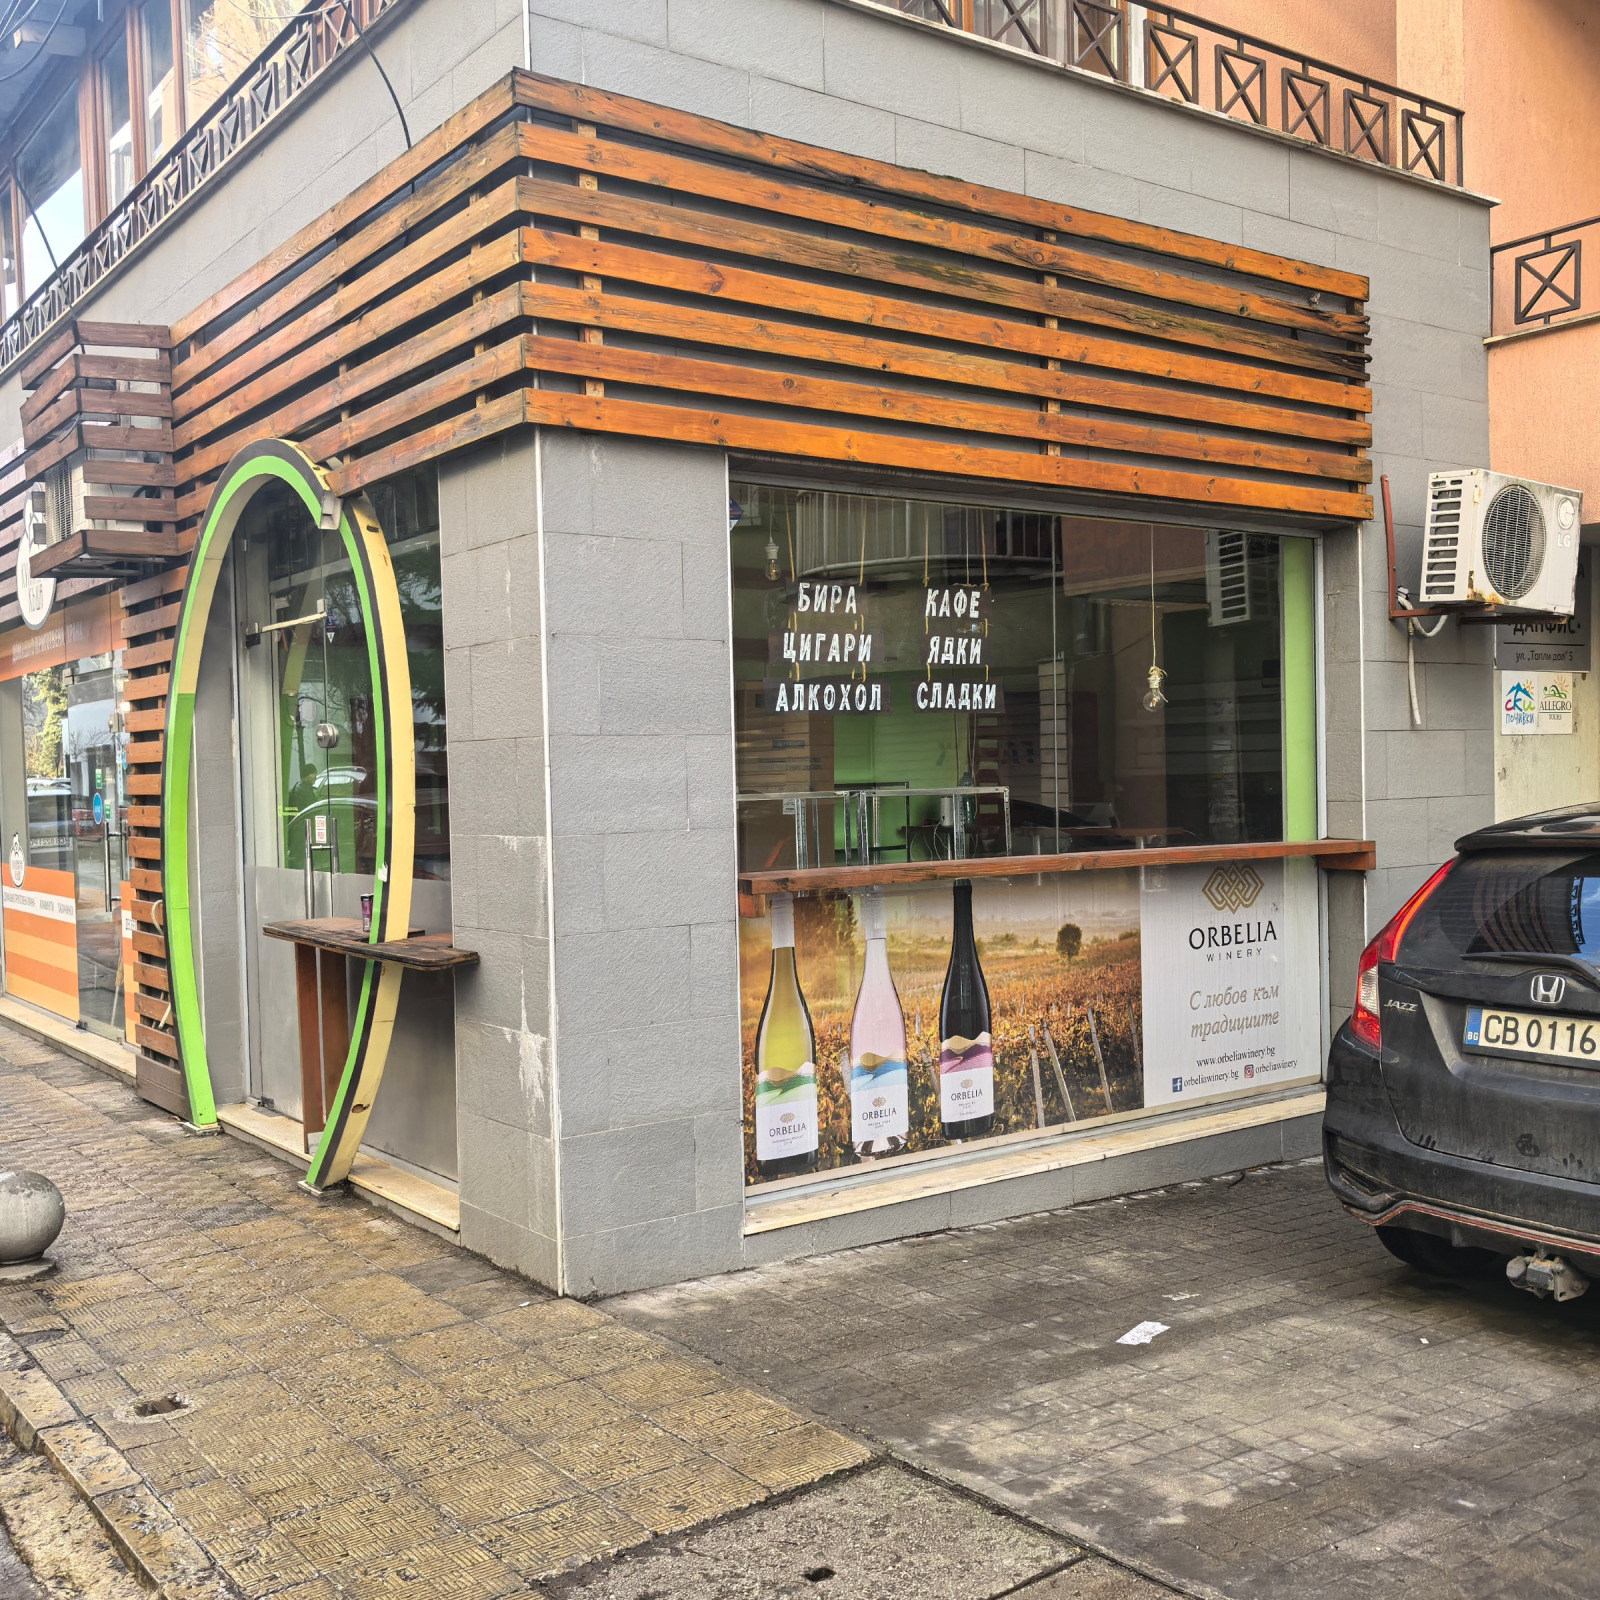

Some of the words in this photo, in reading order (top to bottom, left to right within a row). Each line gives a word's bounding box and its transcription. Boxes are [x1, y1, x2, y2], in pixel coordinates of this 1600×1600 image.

[1557, 532, 1571, 548] LG
[797, 582, 857, 614] БИРА
[925, 588, 980, 618] КАФЕ
[783, 632, 872, 663] ЦИГАРИ
[927, 635, 982, 665] ЯДКИ
[775, 683, 881, 711] АЛКОХОЛ
[916, 681, 996, 710] СЛАДКИ
[1540, 700, 1572, 711] ALLEGRO
[1189, 920, 1277, 950] ORBELIA
[1207, 947, 1262, 962] WINERY
[1190, 990, 1201, 1010] С
[1204, 985, 1247, 1008] любов
[1253, 985, 1279, 1001] към
[1384, 999, 1418, 1012] JAZZ
[1191, 1011, 1279, 1041] традициите
[1467, 1031, 1479, 1041] BG
[1526, 1019, 1597, 1055] 0116
[1196, 1046, 1276, 1067] www.orbeliawinery.bg
[1255, 1059, 1298, 1074] orbeliawinery
[1184, 1069, 1239, 1088] orbeliawinery.bg
[951, 1089, 983, 1101] ORBELIA
[862, 1107, 897, 1121] ORBELIA
[769, 1122, 807, 1137] ORBELIA
